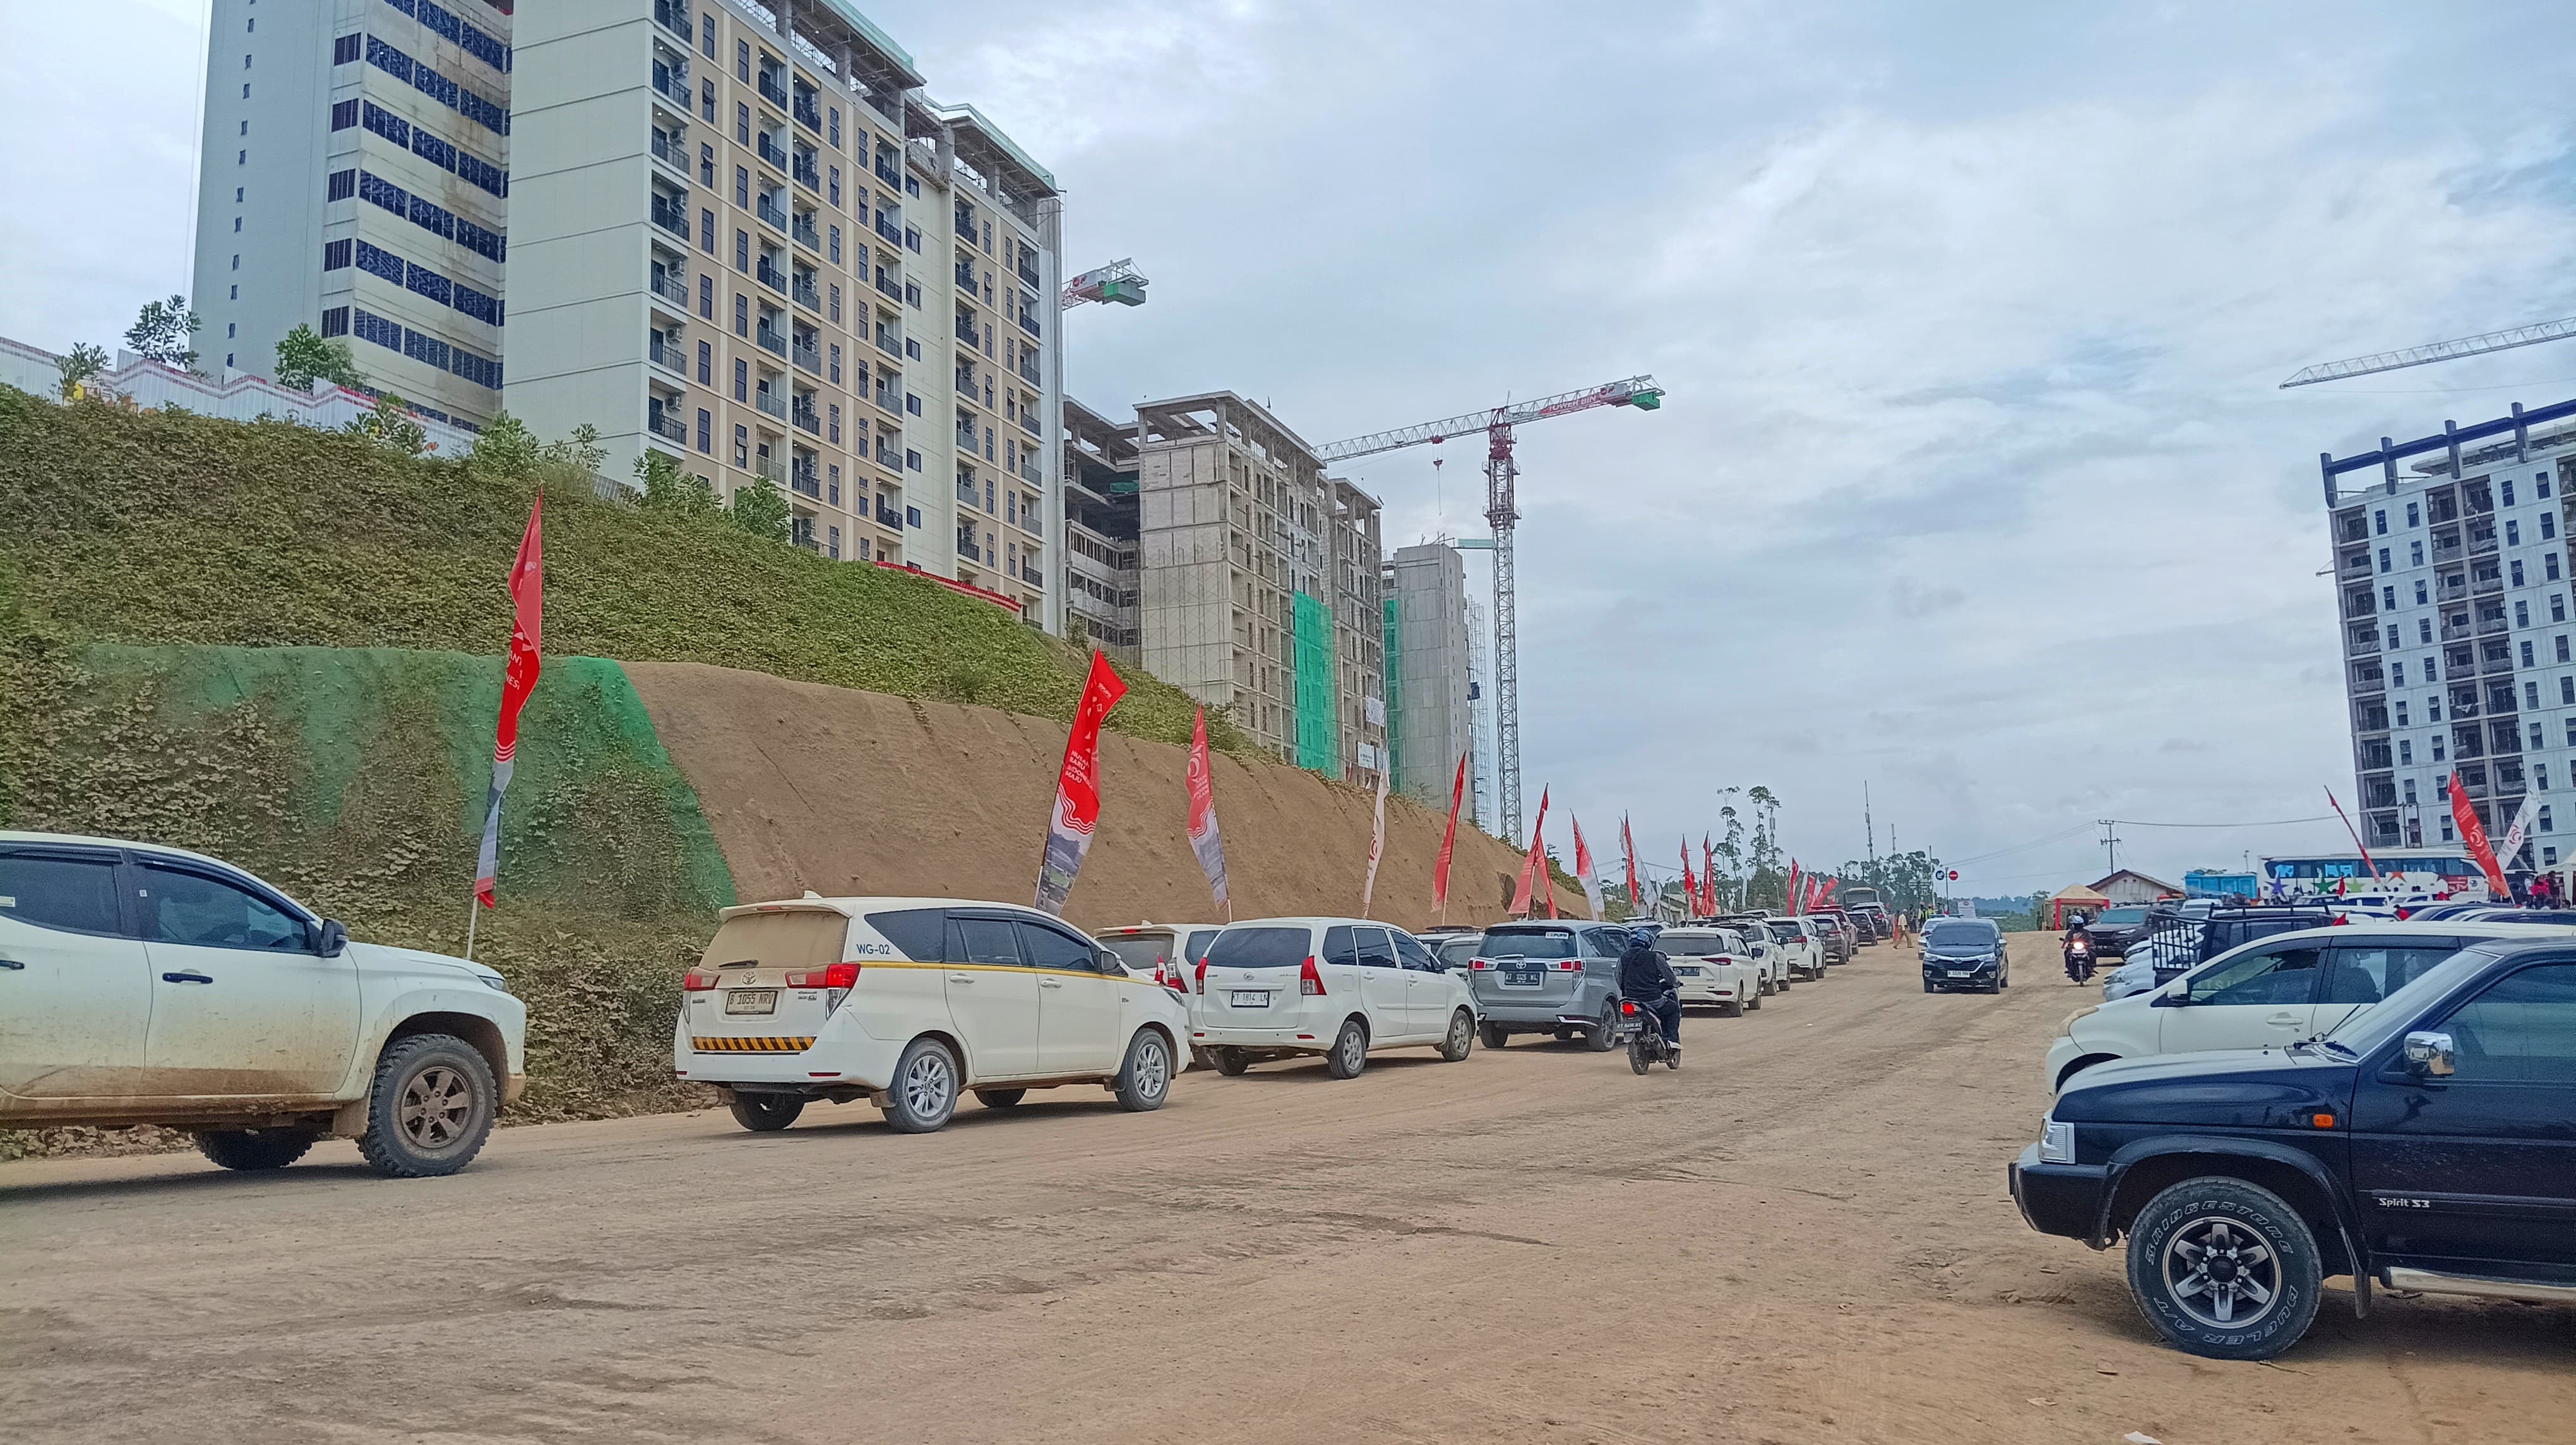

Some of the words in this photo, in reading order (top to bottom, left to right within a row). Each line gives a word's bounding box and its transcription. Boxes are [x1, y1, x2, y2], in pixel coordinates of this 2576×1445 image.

[1065, 770, 1082, 783] MAJU
[856, 944, 890, 954] WG-02
[729, 993, 734, 1005] B
[737, 993, 756, 1005] 1055
[758, 993, 773, 1005] NRV
[1243, 993, 1256, 1001] 1814
[2379, 1198, 2409, 1208] Spirit
[2412, 1199, 2430, 1208] S3
[2145, 1201, 2294, 1266] BRIDGESTONE
[2154, 1297, 2195, 1331] A/T
[2202, 1285, 2299, 1345] DUELER
